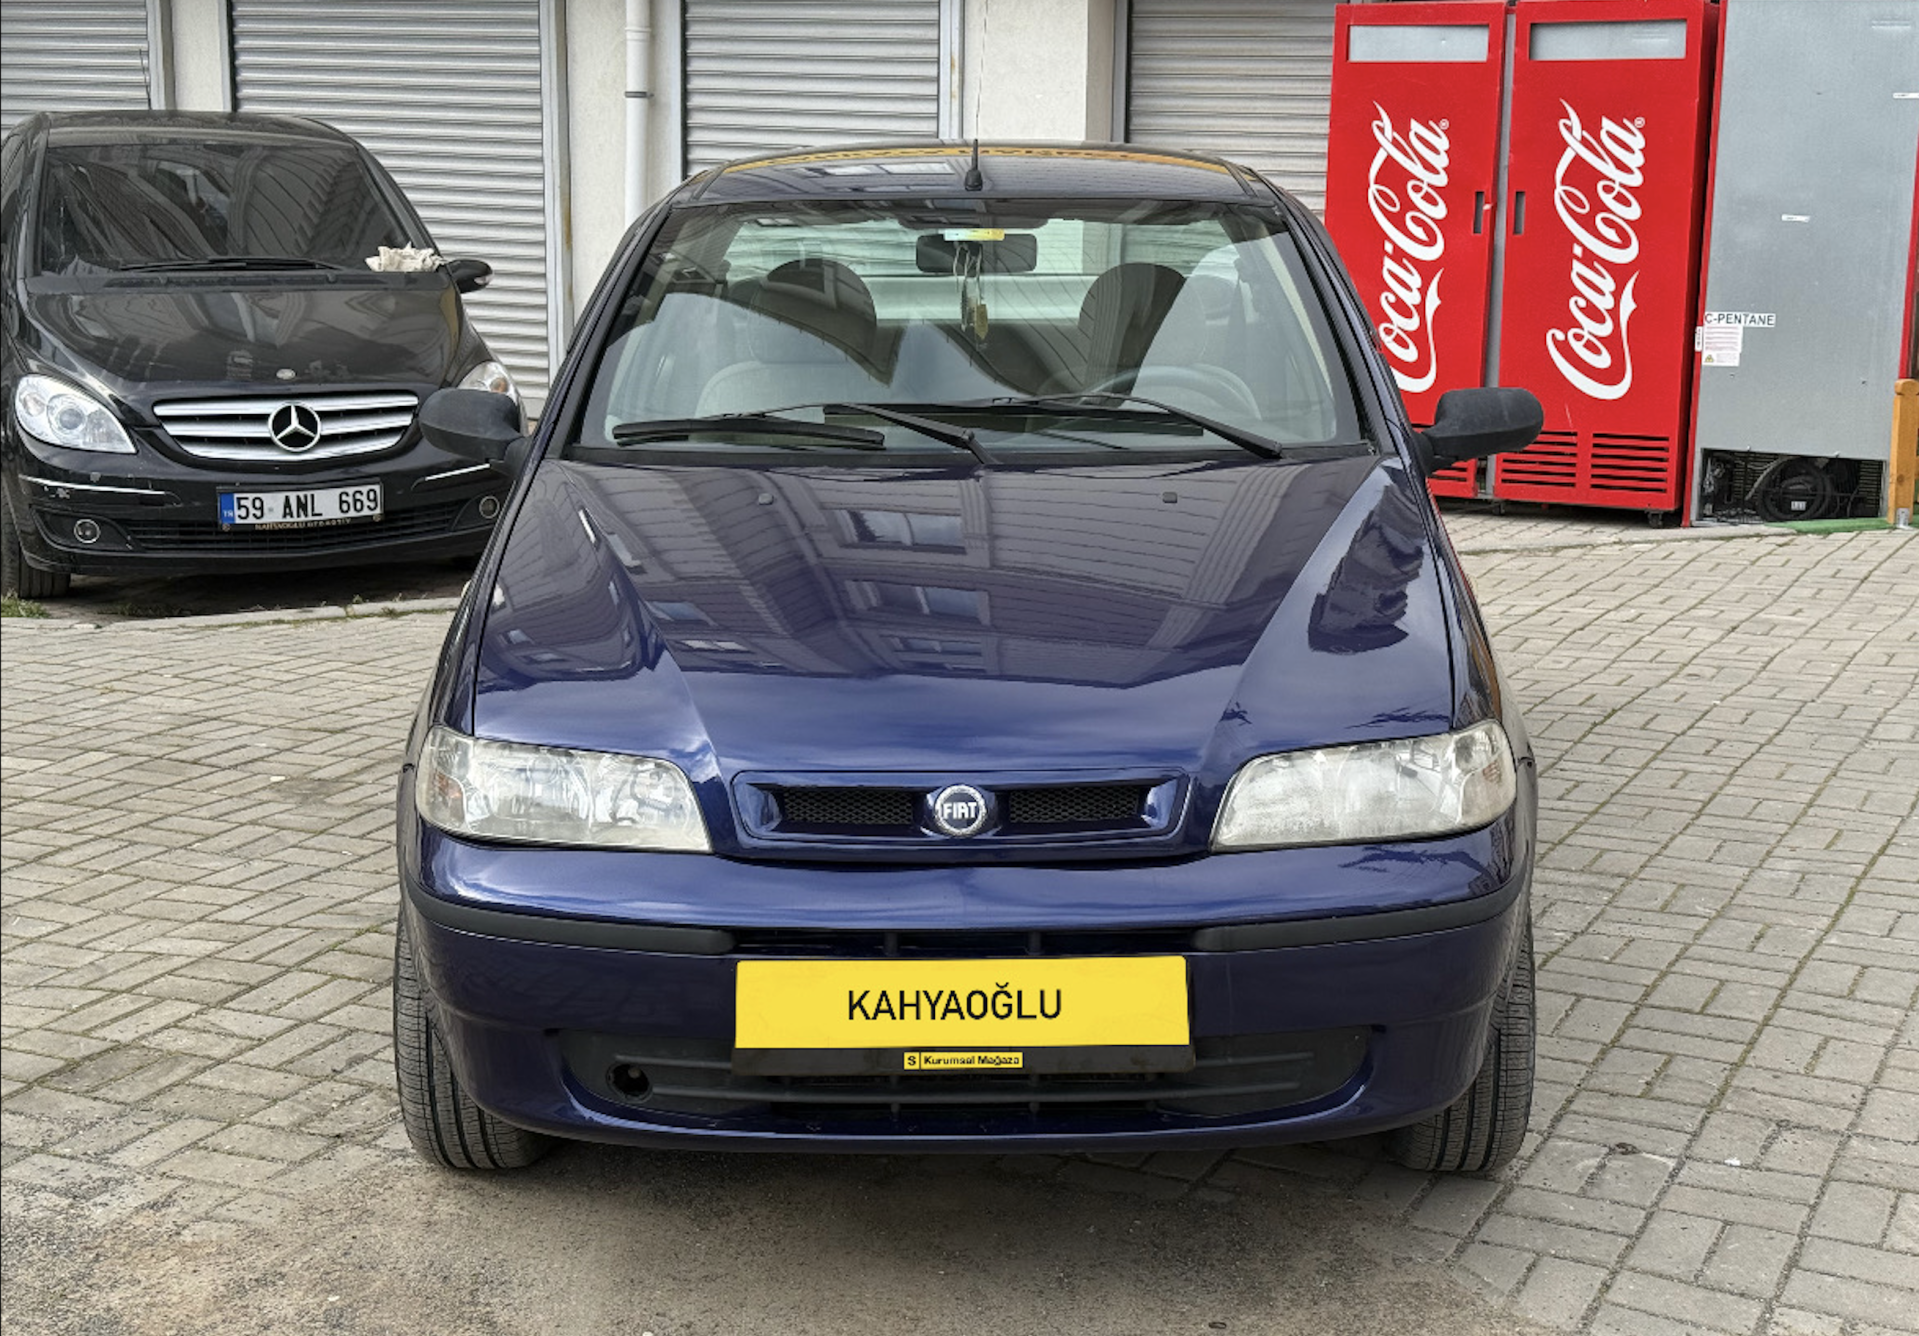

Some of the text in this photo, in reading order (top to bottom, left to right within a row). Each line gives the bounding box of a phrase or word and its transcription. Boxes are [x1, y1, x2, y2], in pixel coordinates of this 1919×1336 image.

[1368, 101, 1450, 393] Coca-Cola
[1546, 98, 1646, 400] Coca-Cola
[1704, 313, 1775, 326] C-PENTANE
[235, 488, 378, 520] 59 ANL 669
[943, 801, 978, 819] FIAT
[848, 982, 1061, 1020] KAHYAOĞLU
[924, 1055, 975, 1065] Kurumsal
[978, 1055, 1020, 1066] Mağaza
